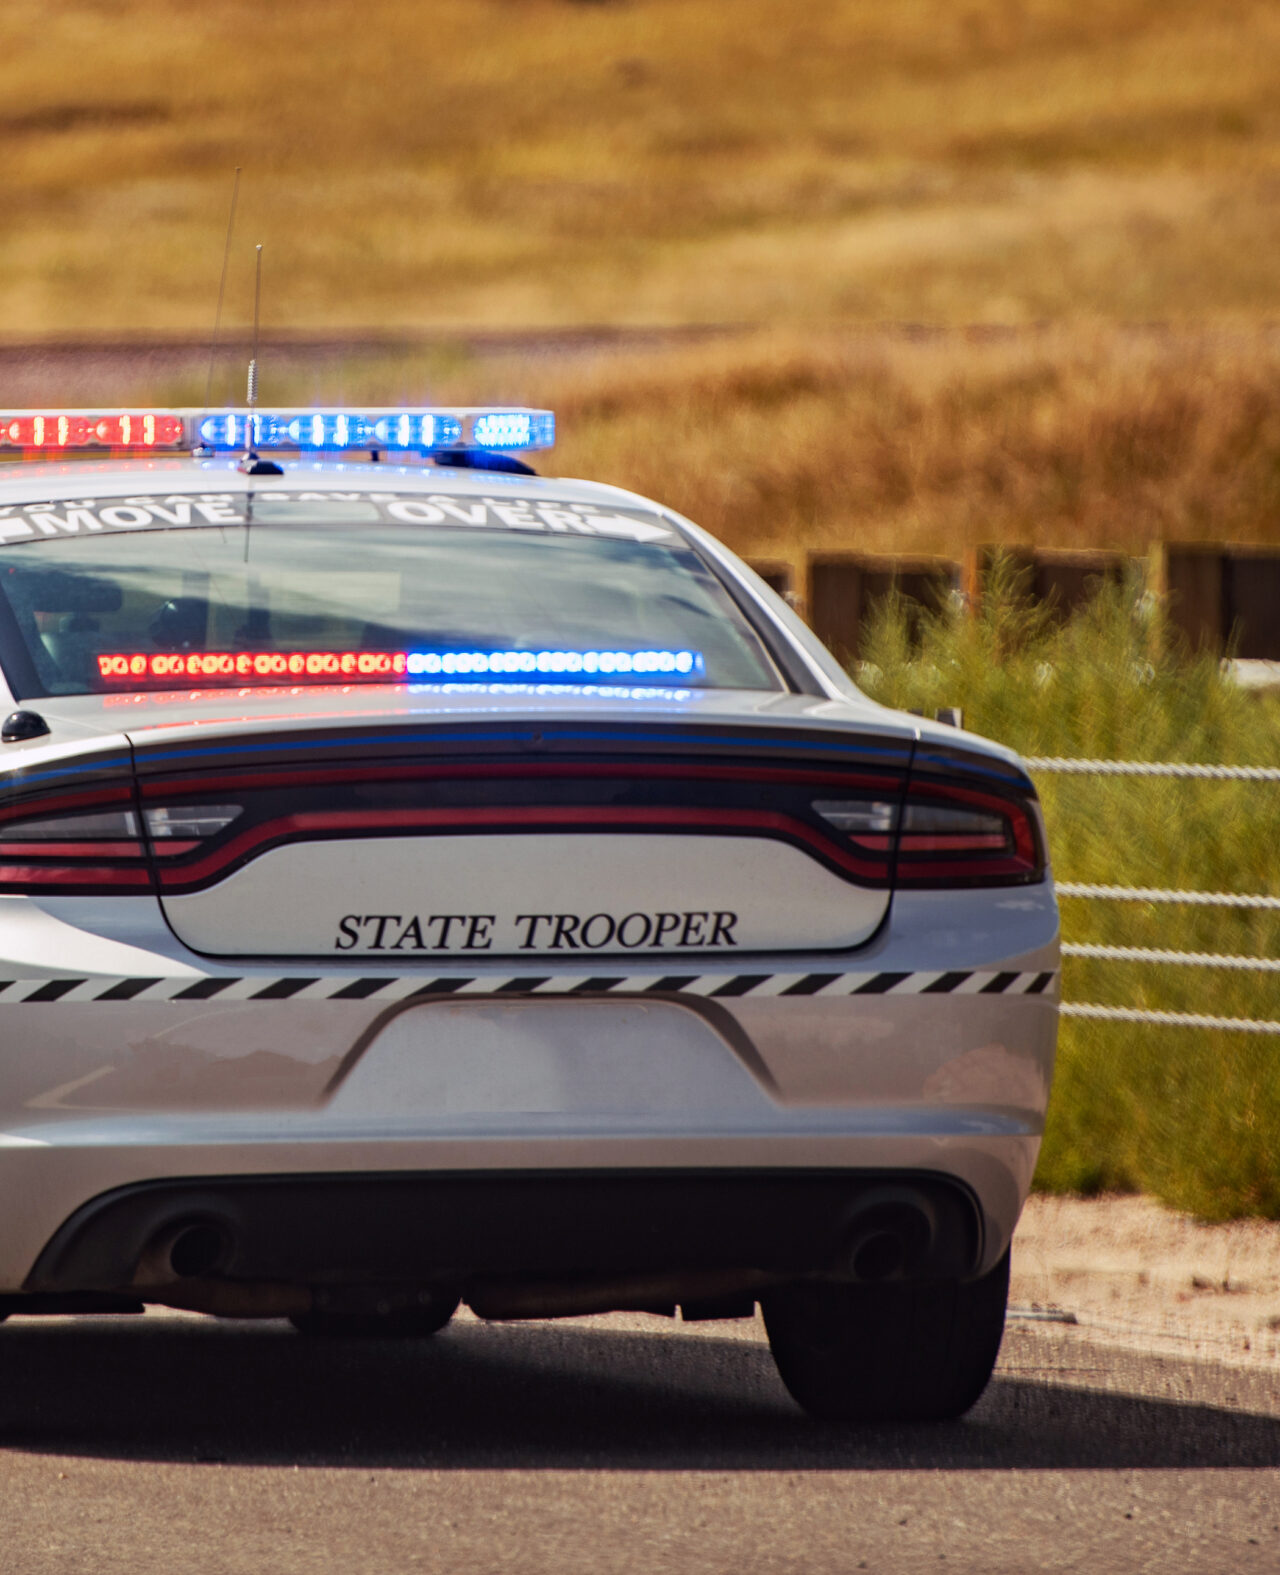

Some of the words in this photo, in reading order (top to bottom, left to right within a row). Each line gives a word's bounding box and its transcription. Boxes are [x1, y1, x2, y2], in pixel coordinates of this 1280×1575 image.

[29, 502, 245, 535] MOVE
[387, 500, 598, 533] OVER
[335, 914, 496, 950] STATE
[515, 911, 739, 949] TROOPER
